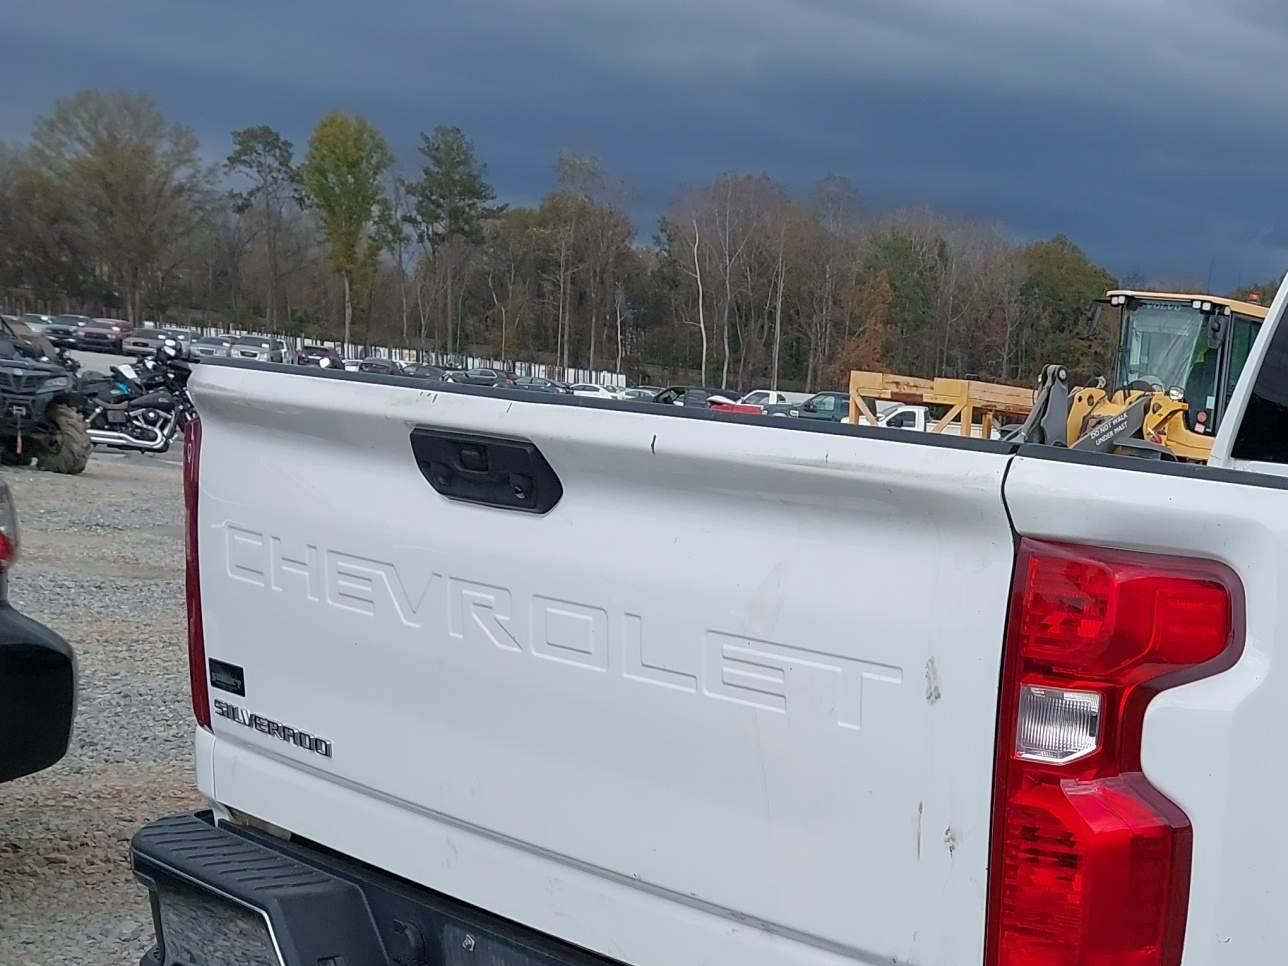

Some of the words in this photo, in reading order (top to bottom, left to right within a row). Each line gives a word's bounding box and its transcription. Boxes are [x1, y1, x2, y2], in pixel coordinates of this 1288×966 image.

[1090, 430, 1100, 440] DO
[1100, 422, 1112, 434] NOT
[1112, 412, 1129, 425] WALK
[1095, 431, 1115, 446] UNDER
[1114, 421, 1128, 434] MAST
[222, 520, 903, 731] CHEVROLET
[214, 698, 332, 758] SILVERADO
